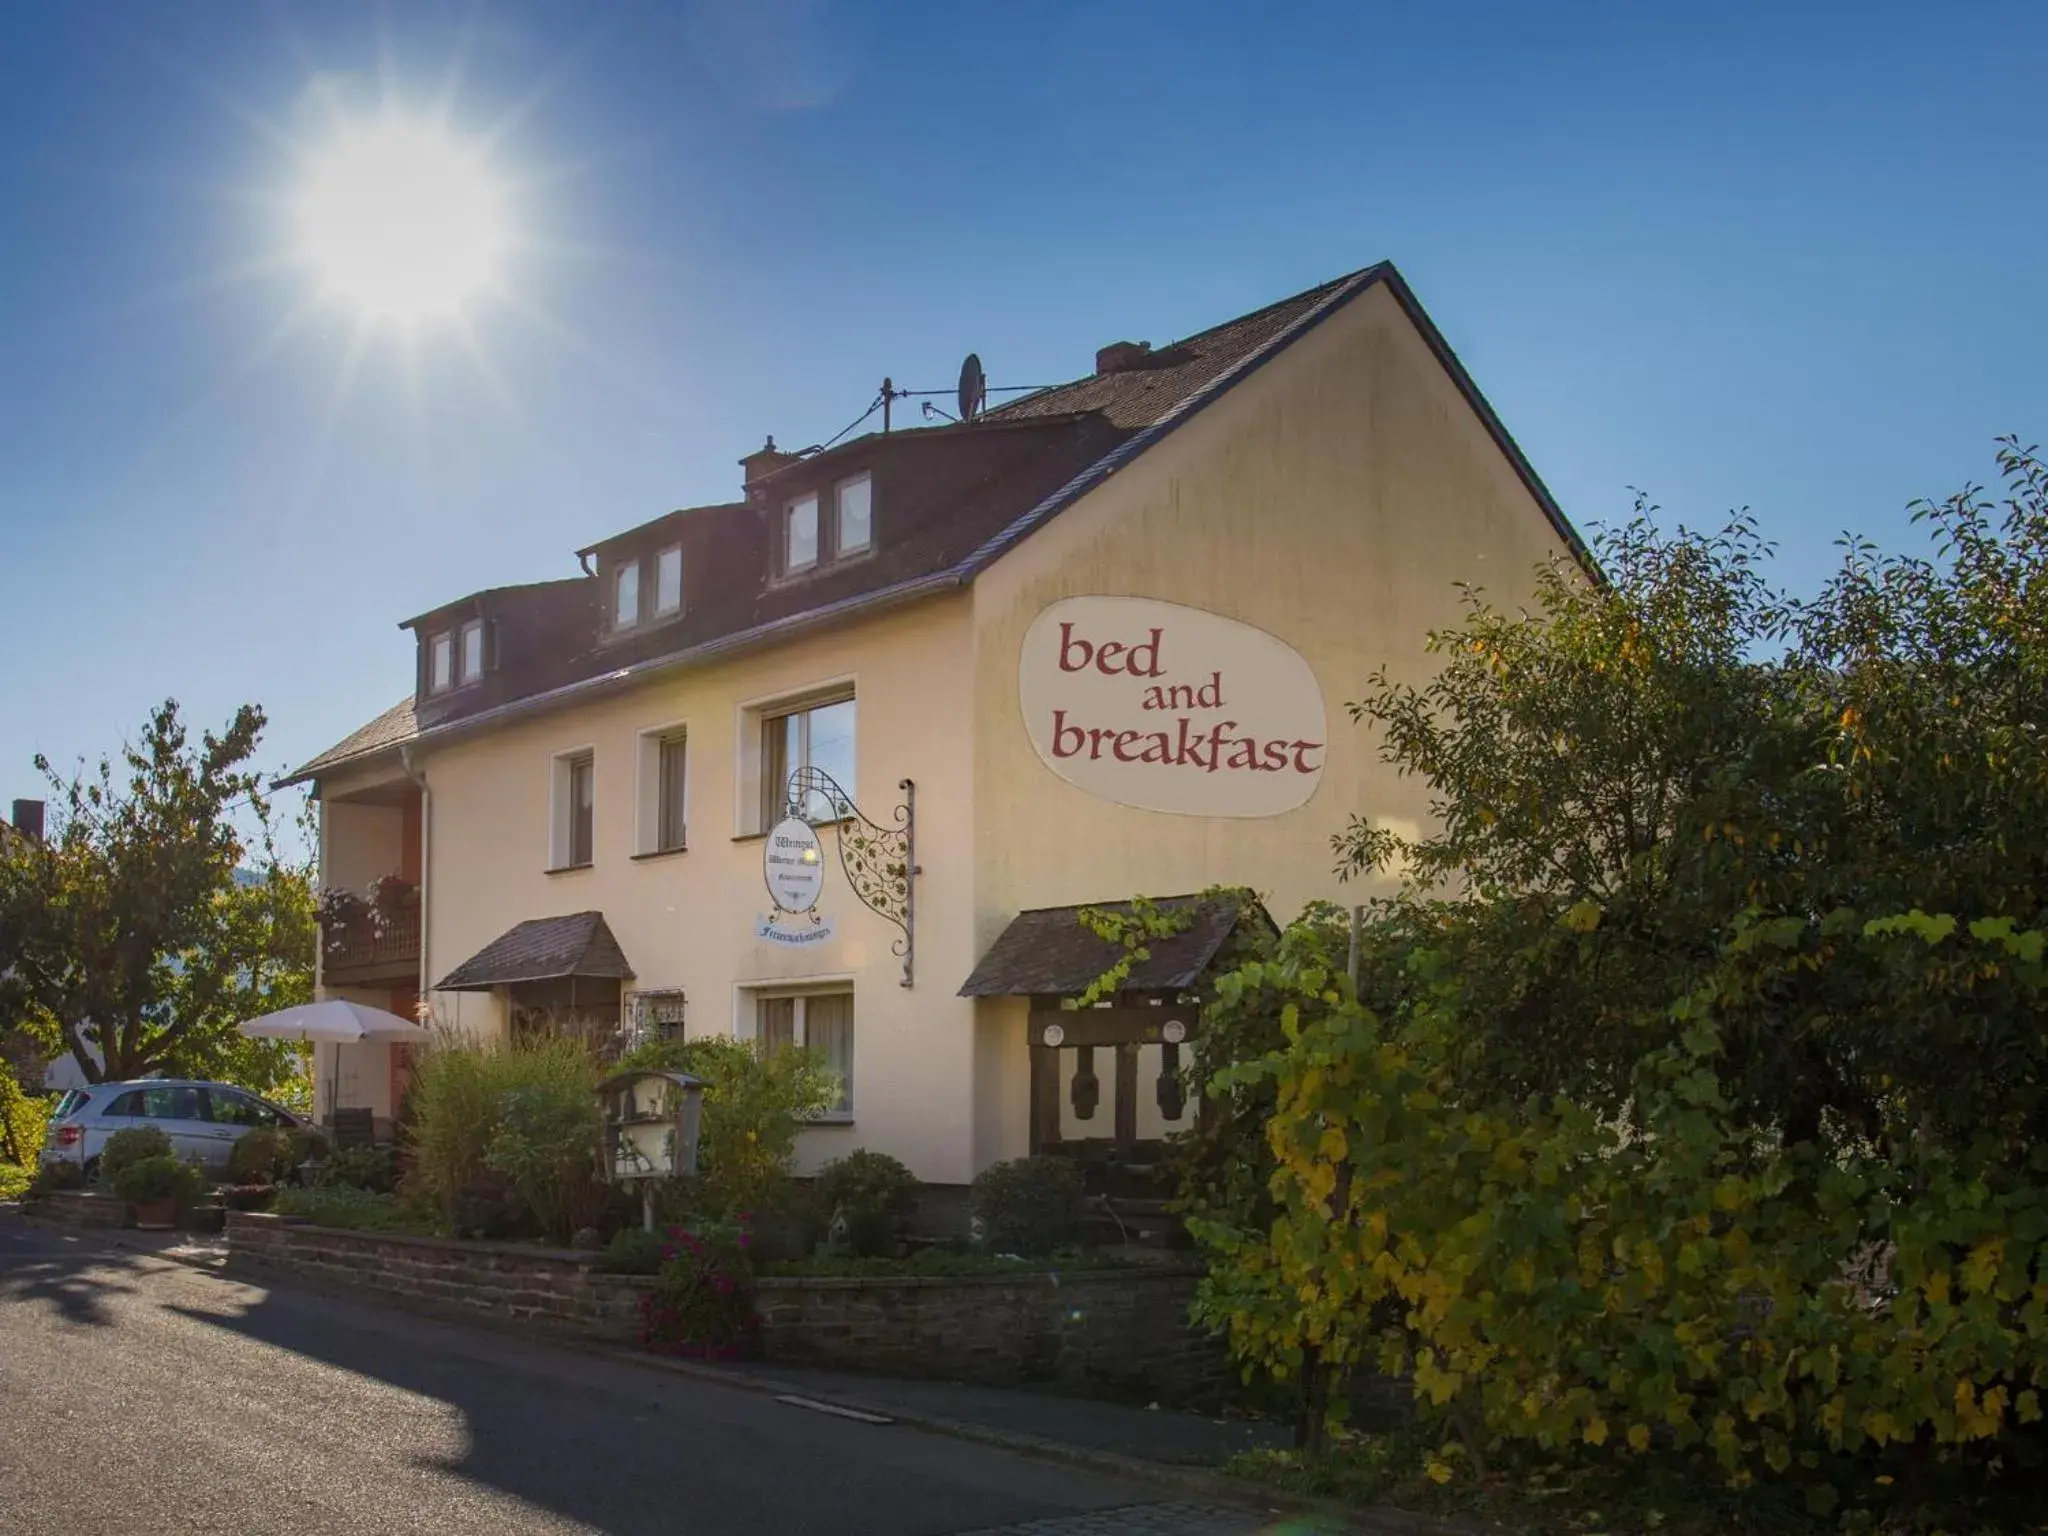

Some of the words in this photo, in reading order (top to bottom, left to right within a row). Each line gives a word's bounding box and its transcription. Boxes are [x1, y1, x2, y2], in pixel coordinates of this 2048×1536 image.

[1058, 622, 1167, 678] bed
[1142, 671, 1228, 711] and
[1051, 708, 1324, 774] breakfast
